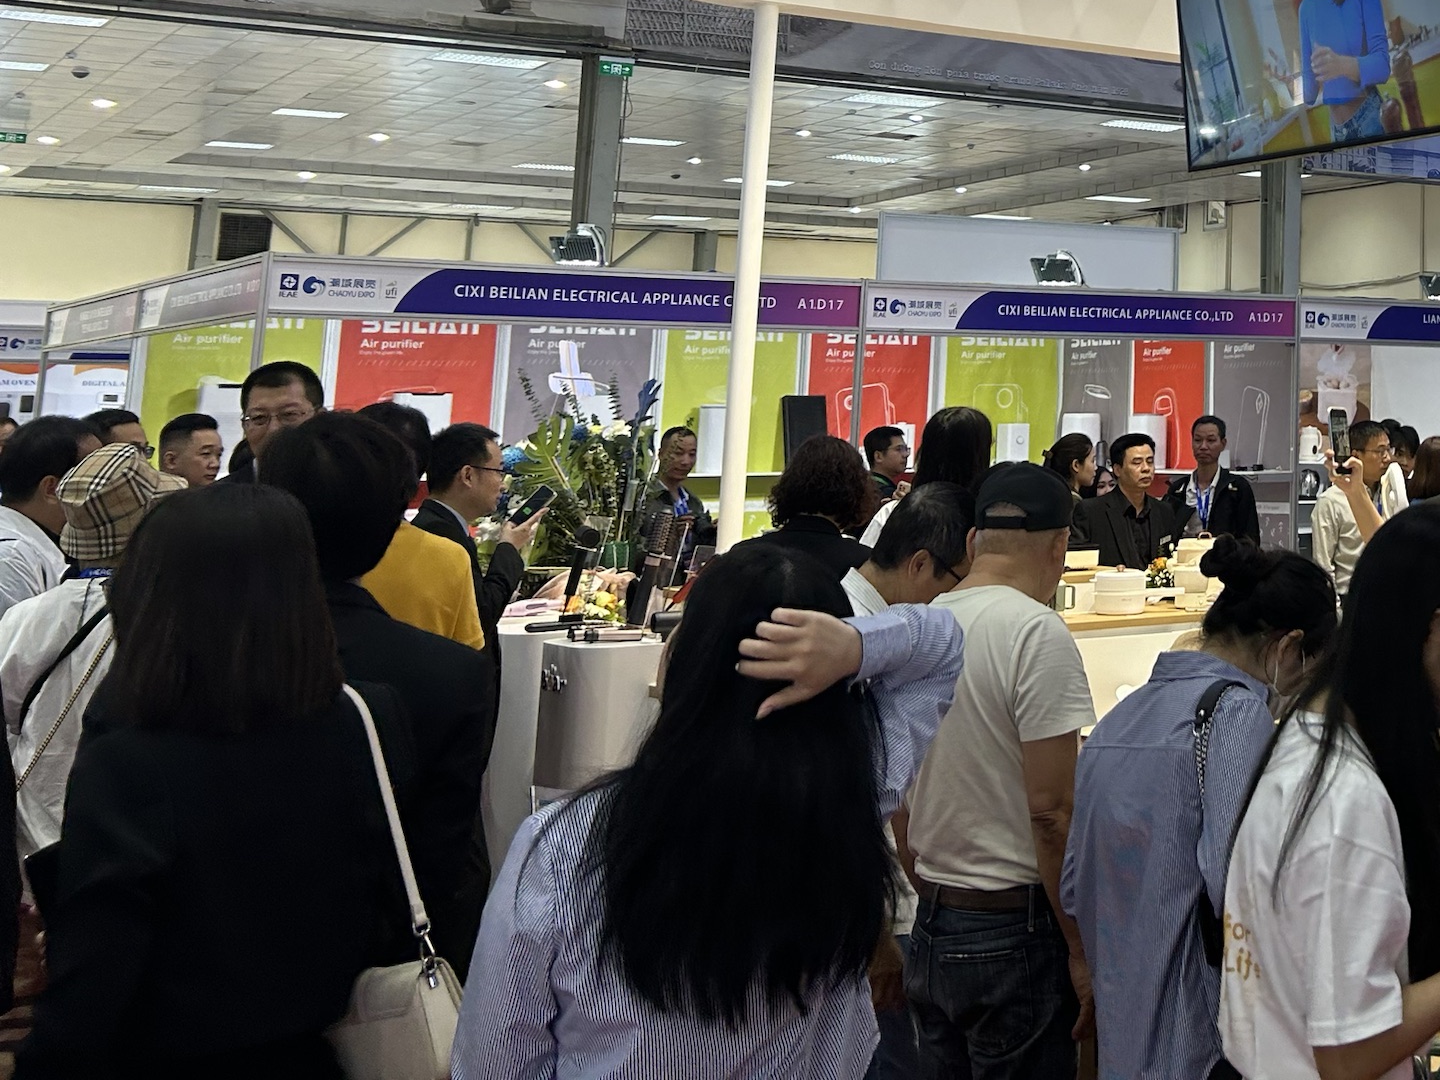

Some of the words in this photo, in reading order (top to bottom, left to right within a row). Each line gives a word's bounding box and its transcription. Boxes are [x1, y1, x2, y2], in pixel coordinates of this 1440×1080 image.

[328, 289, 357, 298] CHAOYU
[357, 290, 375, 298] EXPO
[453, 284, 485, 298] CIXI
[489, 286, 548, 300] BEILIAN
[552, 289, 638, 304] ELECTRICAL
[642, 292, 720, 307] APPLIANCE
[998, 304, 1020, 316] CIXI
[1024, 305, 1066, 317] BEILIAN
[1070, 307, 1132, 319] ELECTRICAL
[1135, 308, 1192, 320] APPLIANCE
[1194, 310, 1234, 322] CO.,LTD
[173, 333, 191, 343] Air
[196, 333, 243, 345] purifier
[360, 338, 378, 348] Air
[381, 339, 424, 350] purifier
[528, 338, 545, 348] Air
[684, 345, 699, 354] Air
[826, 348, 840, 357] Air
[1224, 344, 1232, 353] Air
[1233, 343, 1255, 354] purifier
[961, 350, 973, 359] Air
[976, 351, 1006, 360] purifier
